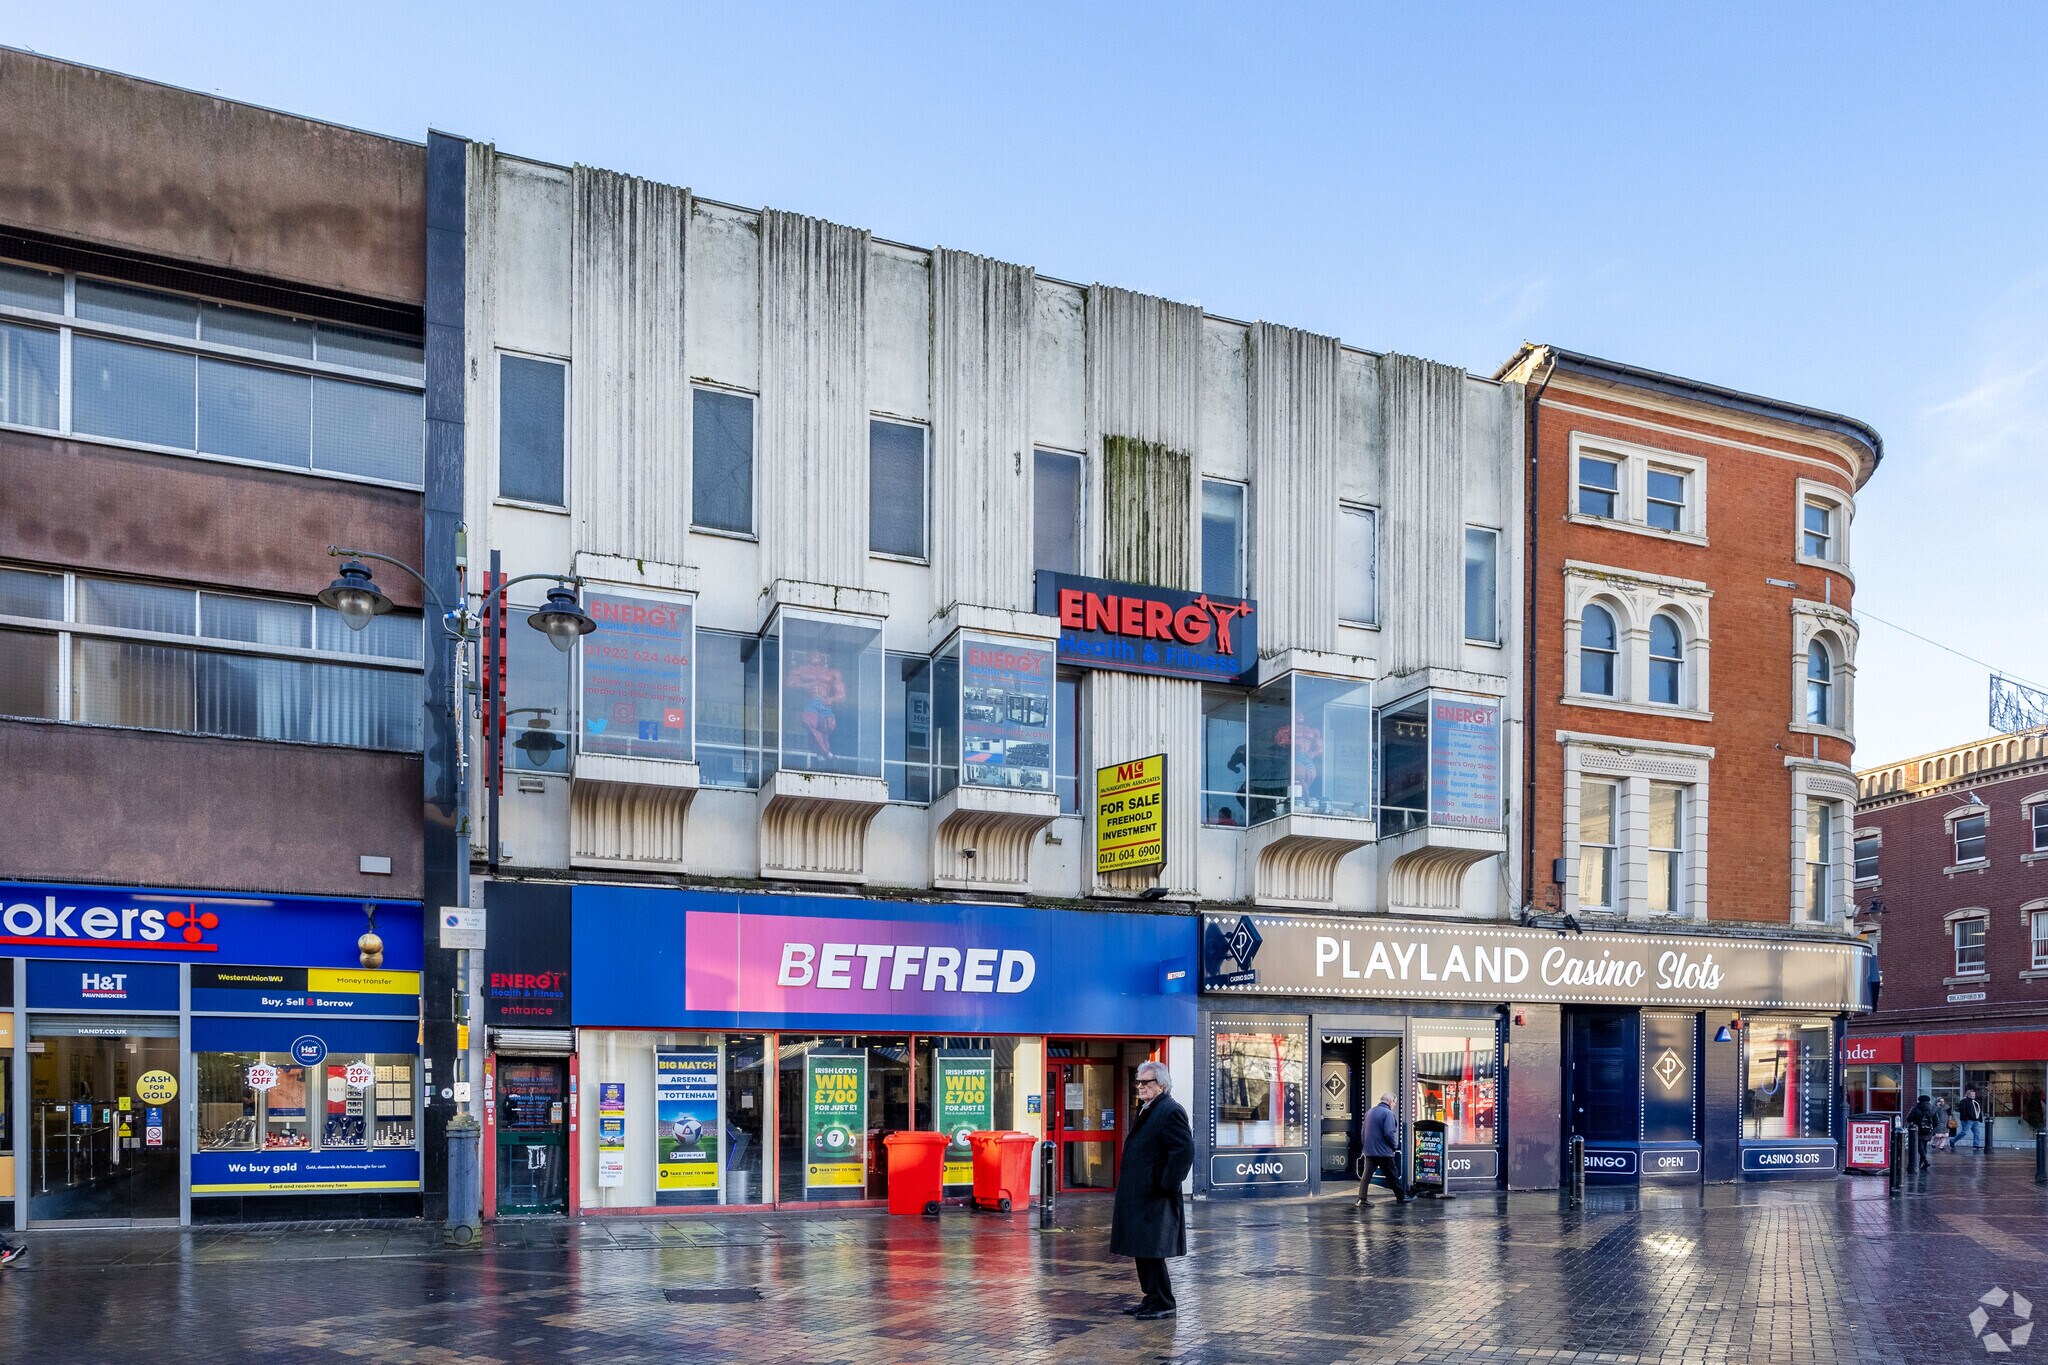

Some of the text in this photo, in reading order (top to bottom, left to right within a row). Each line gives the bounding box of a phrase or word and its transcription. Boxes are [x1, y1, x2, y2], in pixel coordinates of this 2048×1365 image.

[590, 601, 687, 631] ENERGY
[1059, 588, 1253, 654] ENERGY
[585, 645, 688, 666] 01922 624 466
[1060, 634, 1239, 673] Health & Fitness
[969, 649, 1049, 676] ENERGY
[592, 676, 621, 685] Follow
[586, 687, 614, 695] media
[631, 691, 647, 699] find
[669, 695, 686, 703] why
[1436, 705, 1498, 727] ENERGY
[1434, 758, 1461, 767] Women's
[1463, 761, 1476, 769] Only
[1132, 776, 1160, 787] ASSOCIATES
[1459, 771, 1478, 779] Beauty
[1101, 793, 1160, 815] FOR SALE
[1107, 811, 1153, 827] FREEHOLD
[1432, 811, 1499, 826] & Much More!!
[1102, 823, 1157, 840] INVESTMENT
[1100, 844, 1160, 863] 0121 604 6900
[0, 896, 166, 941] okers
[776, 942, 1036, 994] BETFRED
[1315, 936, 1725, 990] PLAYLAND Casino Slots
[82, 973, 127, 990] H&T
[337, 977, 362, 985] Money
[490, 971, 567, 990] ENERGY
[491, 988, 521, 997] Health
[533, 989, 564, 998] Fitness
[262, 997, 354, 1008] Buy, Sell & Borrow
[501, 1006, 553, 1015] entrance
[301, 1045, 318, 1053] H&T
[659, 1061, 716, 1070] BIG MATCH
[815, 1074, 857, 1090] WIN
[945, 1076, 985, 1091] WIN
[815, 1090, 857, 1104] £700
[945, 1091, 985, 1104] £700
[832, 1134, 839, 1142] 7
[962, 1133, 967, 1142] 7
[1447, 1159, 1471, 1170] LOTS
[1584, 1157, 1626, 1168] BINGO
[1658, 1157, 1684, 1168] OPEN
[1759, 1153, 1820, 1164] CASINO SLOTS
[228, 1163, 297, 1174] We buy gold
[1236, 1163, 1284, 1175] CASINO
